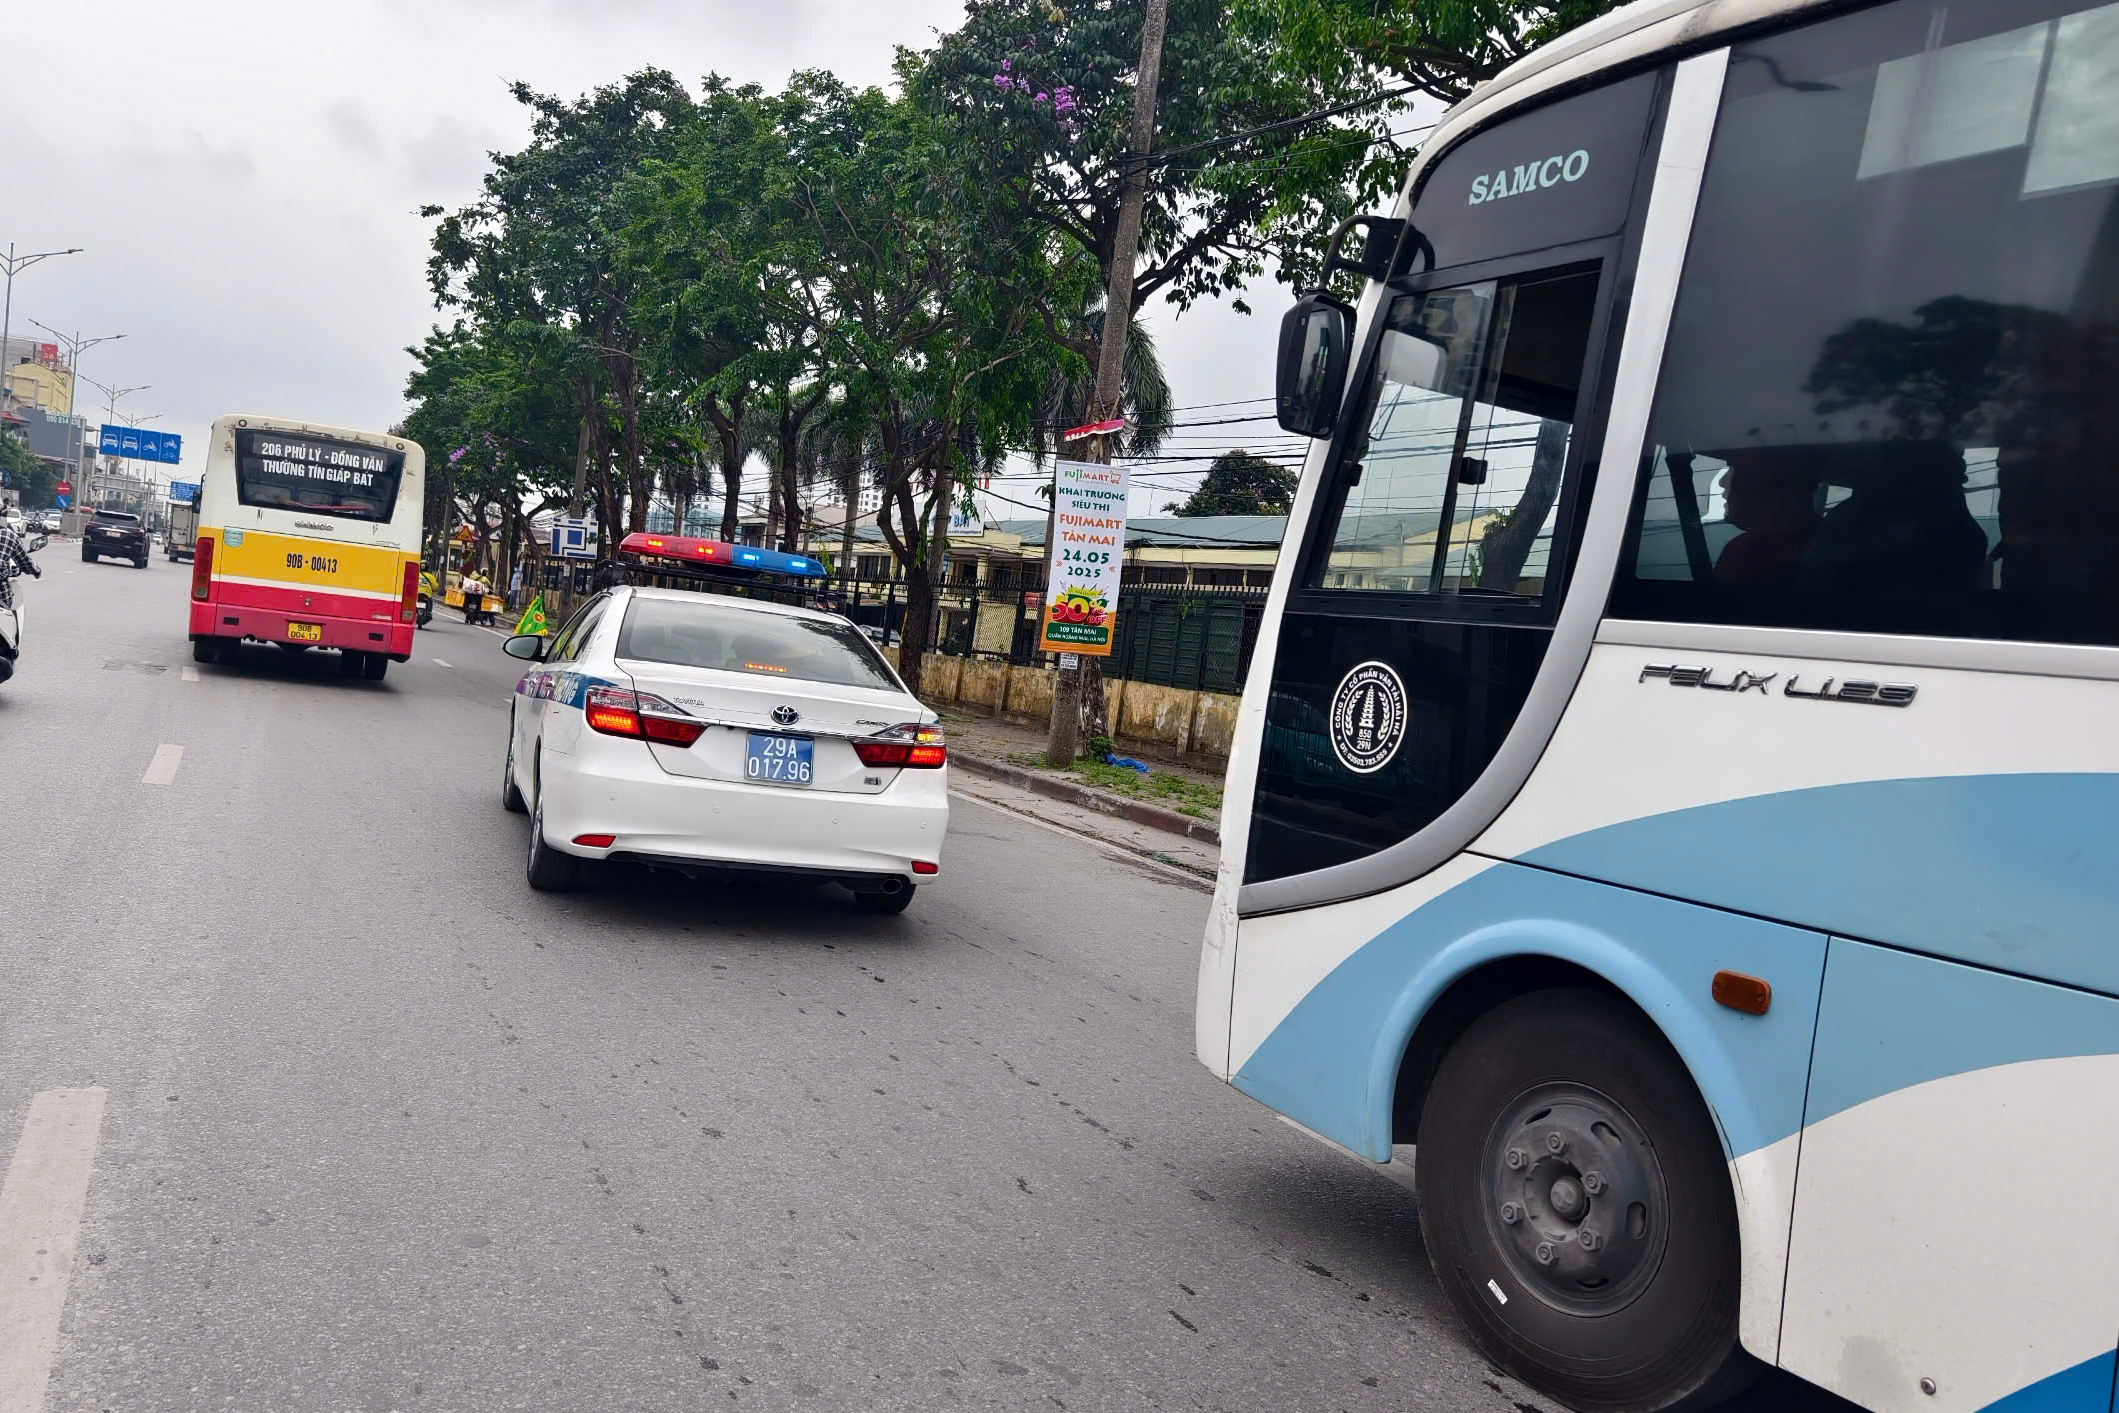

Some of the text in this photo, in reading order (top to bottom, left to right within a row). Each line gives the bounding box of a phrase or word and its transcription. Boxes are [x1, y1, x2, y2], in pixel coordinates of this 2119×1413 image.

[1469, 150, 1589, 205] SAMCO
[284, 443, 307, 460] PHỦ
[308, 447, 322, 462] LÝ
[330, 450, 360, 468] ĐỒNG
[362, 455, 384, 473] VĂN
[262, 458, 306, 477] THƯỜNG
[308, 464, 326, 480] TÍN
[353, 470, 374, 487] BÁT
[1059, 487, 1125, 501] KHAI TRƯƠNG
[1071, 499, 1110, 514] SIÊU THỊ
[1059, 513, 1123, 530] FUJIMART
[1062, 529, 1116, 547] TÂN MAI
[286, 553, 303, 569] 90B
[310, 556, 338, 574] 00413
[1063, 548, 1110, 565] 24.05
[1067, 566, 1102, 578] 2025
[1334, 701, 1344, 729] CÔNG
[1340, 687, 1349, 699] TY
[763, 736, 798, 759] 29A
[748, 756, 811, 781] 017.96
